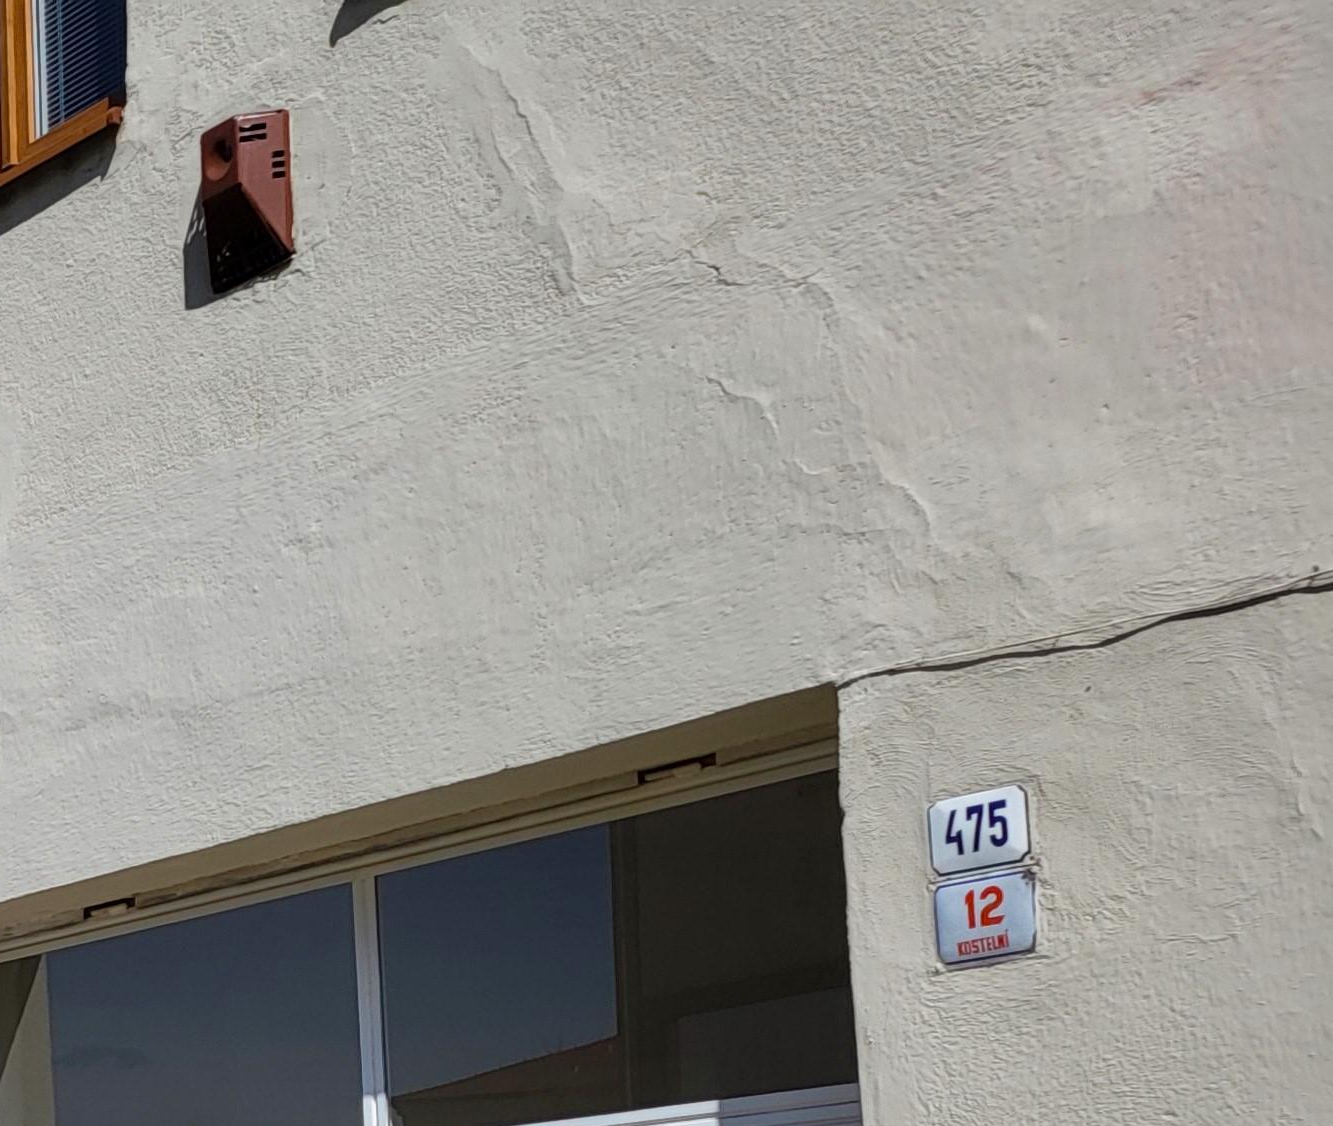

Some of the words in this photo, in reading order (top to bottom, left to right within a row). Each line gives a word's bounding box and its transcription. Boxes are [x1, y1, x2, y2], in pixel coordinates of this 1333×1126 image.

[945, 799, 1009, 855] 475
[964, 885, 1006, 930] 12
[956, 930, 1010, 957] KOSTELNÍ
